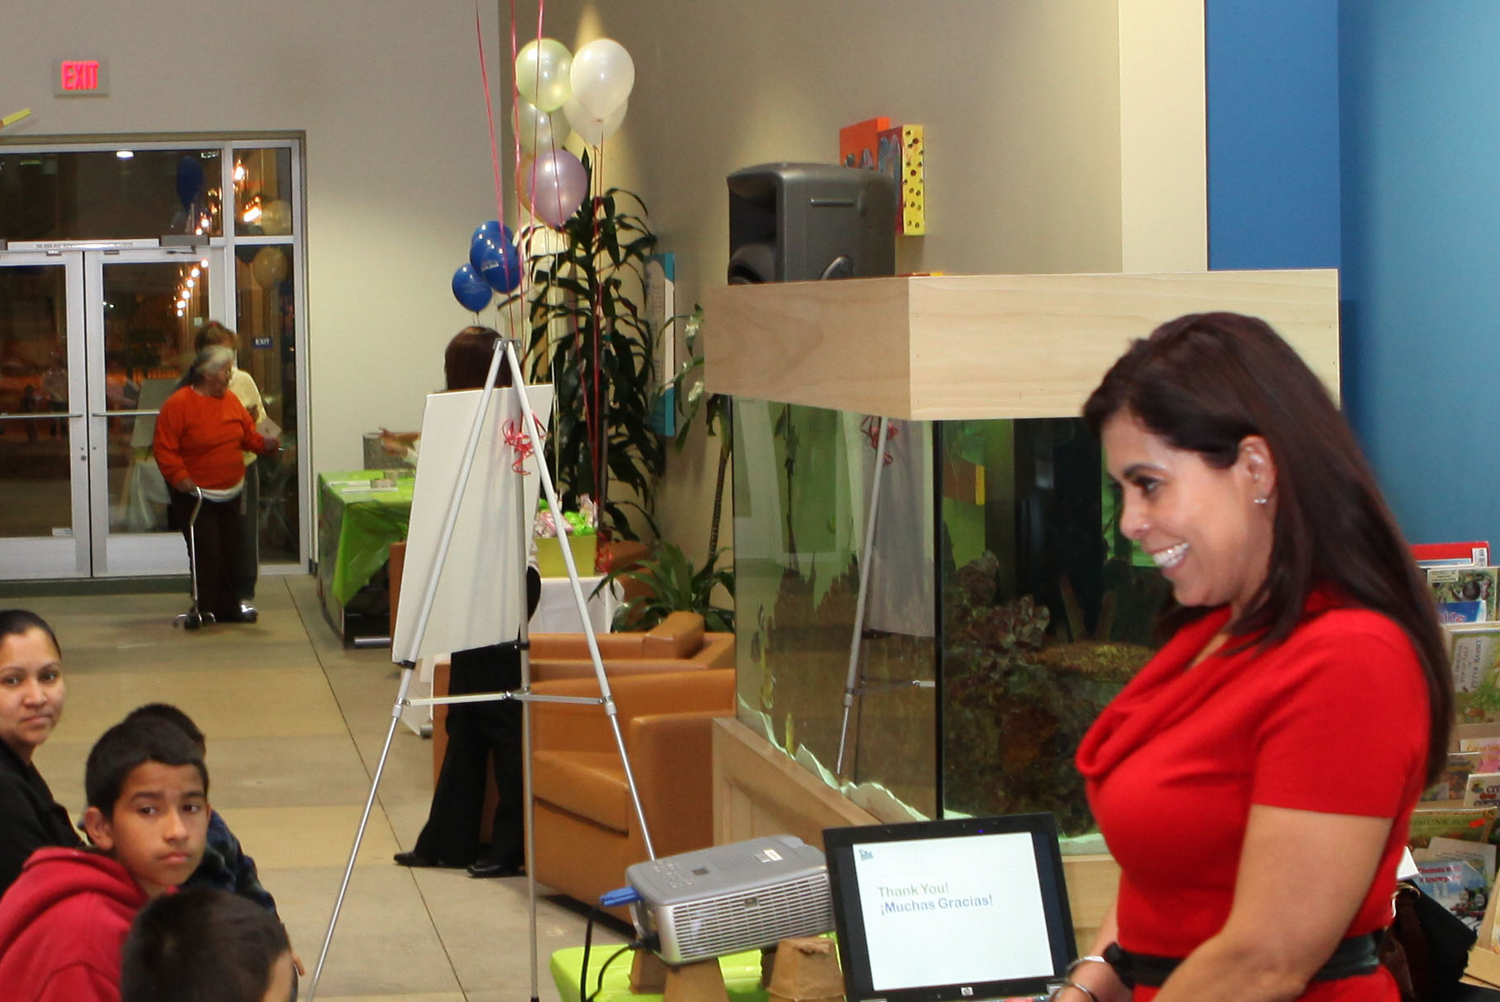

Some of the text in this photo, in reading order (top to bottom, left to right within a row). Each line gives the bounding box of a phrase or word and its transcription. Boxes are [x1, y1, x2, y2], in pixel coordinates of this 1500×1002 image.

[61, 60, 99, 90] EXIT
[255, 338, 270, 346] EXIT
[878, 882, 949, 898] Thank You!
[880, 894, 993, 916] ¡Muchas Gracias!
